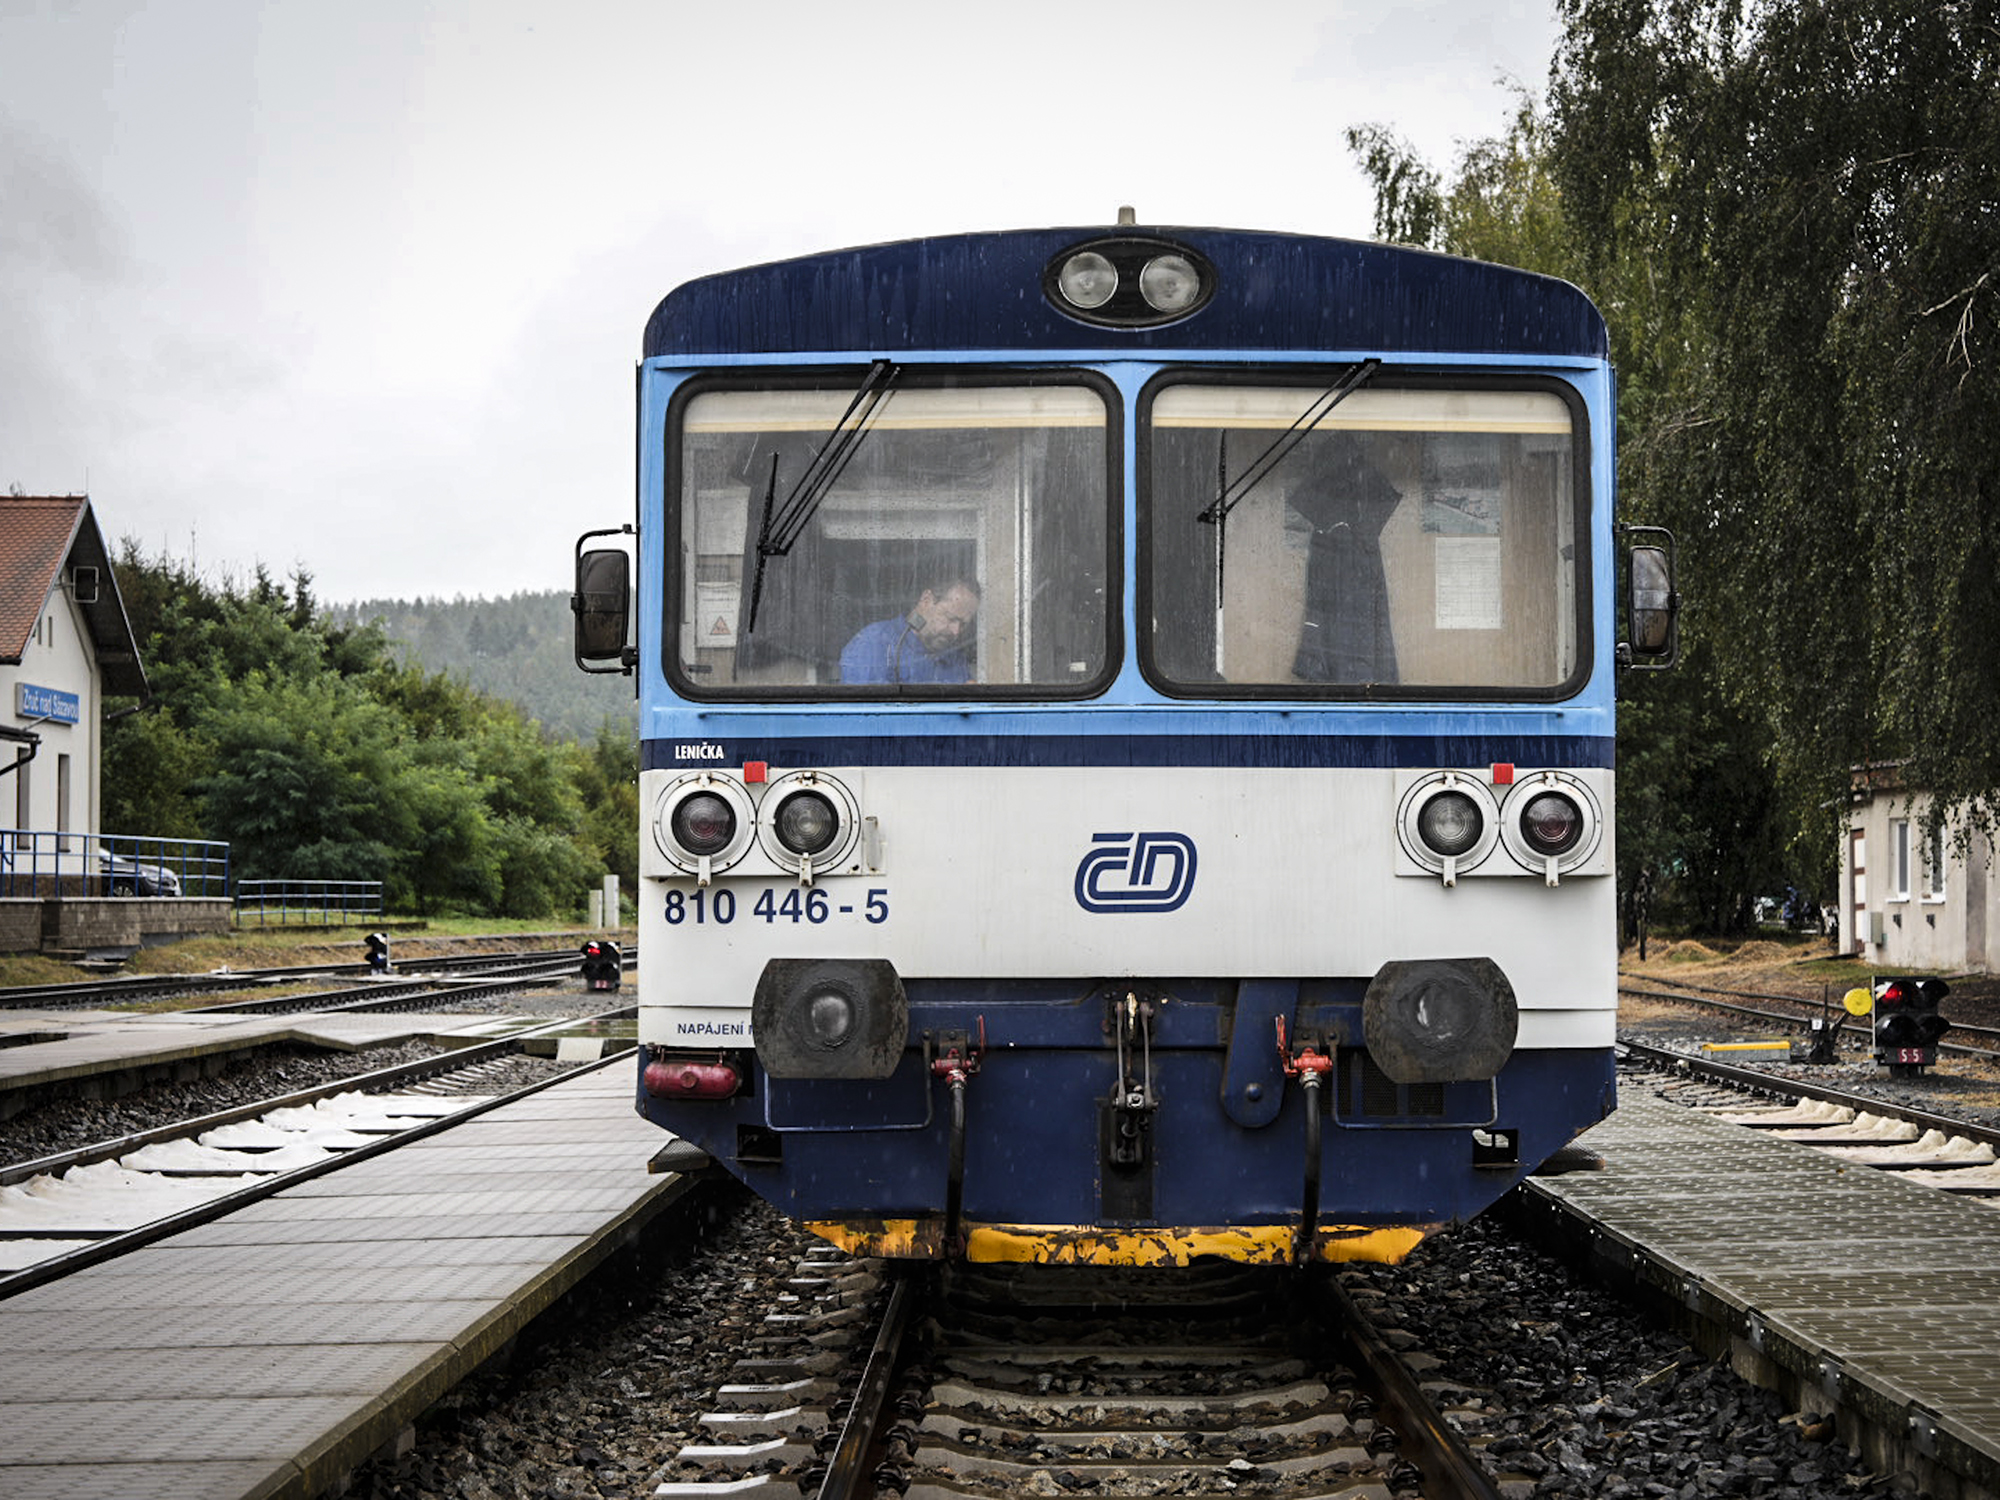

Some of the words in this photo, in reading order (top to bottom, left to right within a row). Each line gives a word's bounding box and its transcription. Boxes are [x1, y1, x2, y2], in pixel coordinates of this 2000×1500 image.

[675, 741, 725, 759] LENIČKA
[664, 888, 736, 924] 810
[677, 1021, 744, 1035] NAPÁJENÍ
